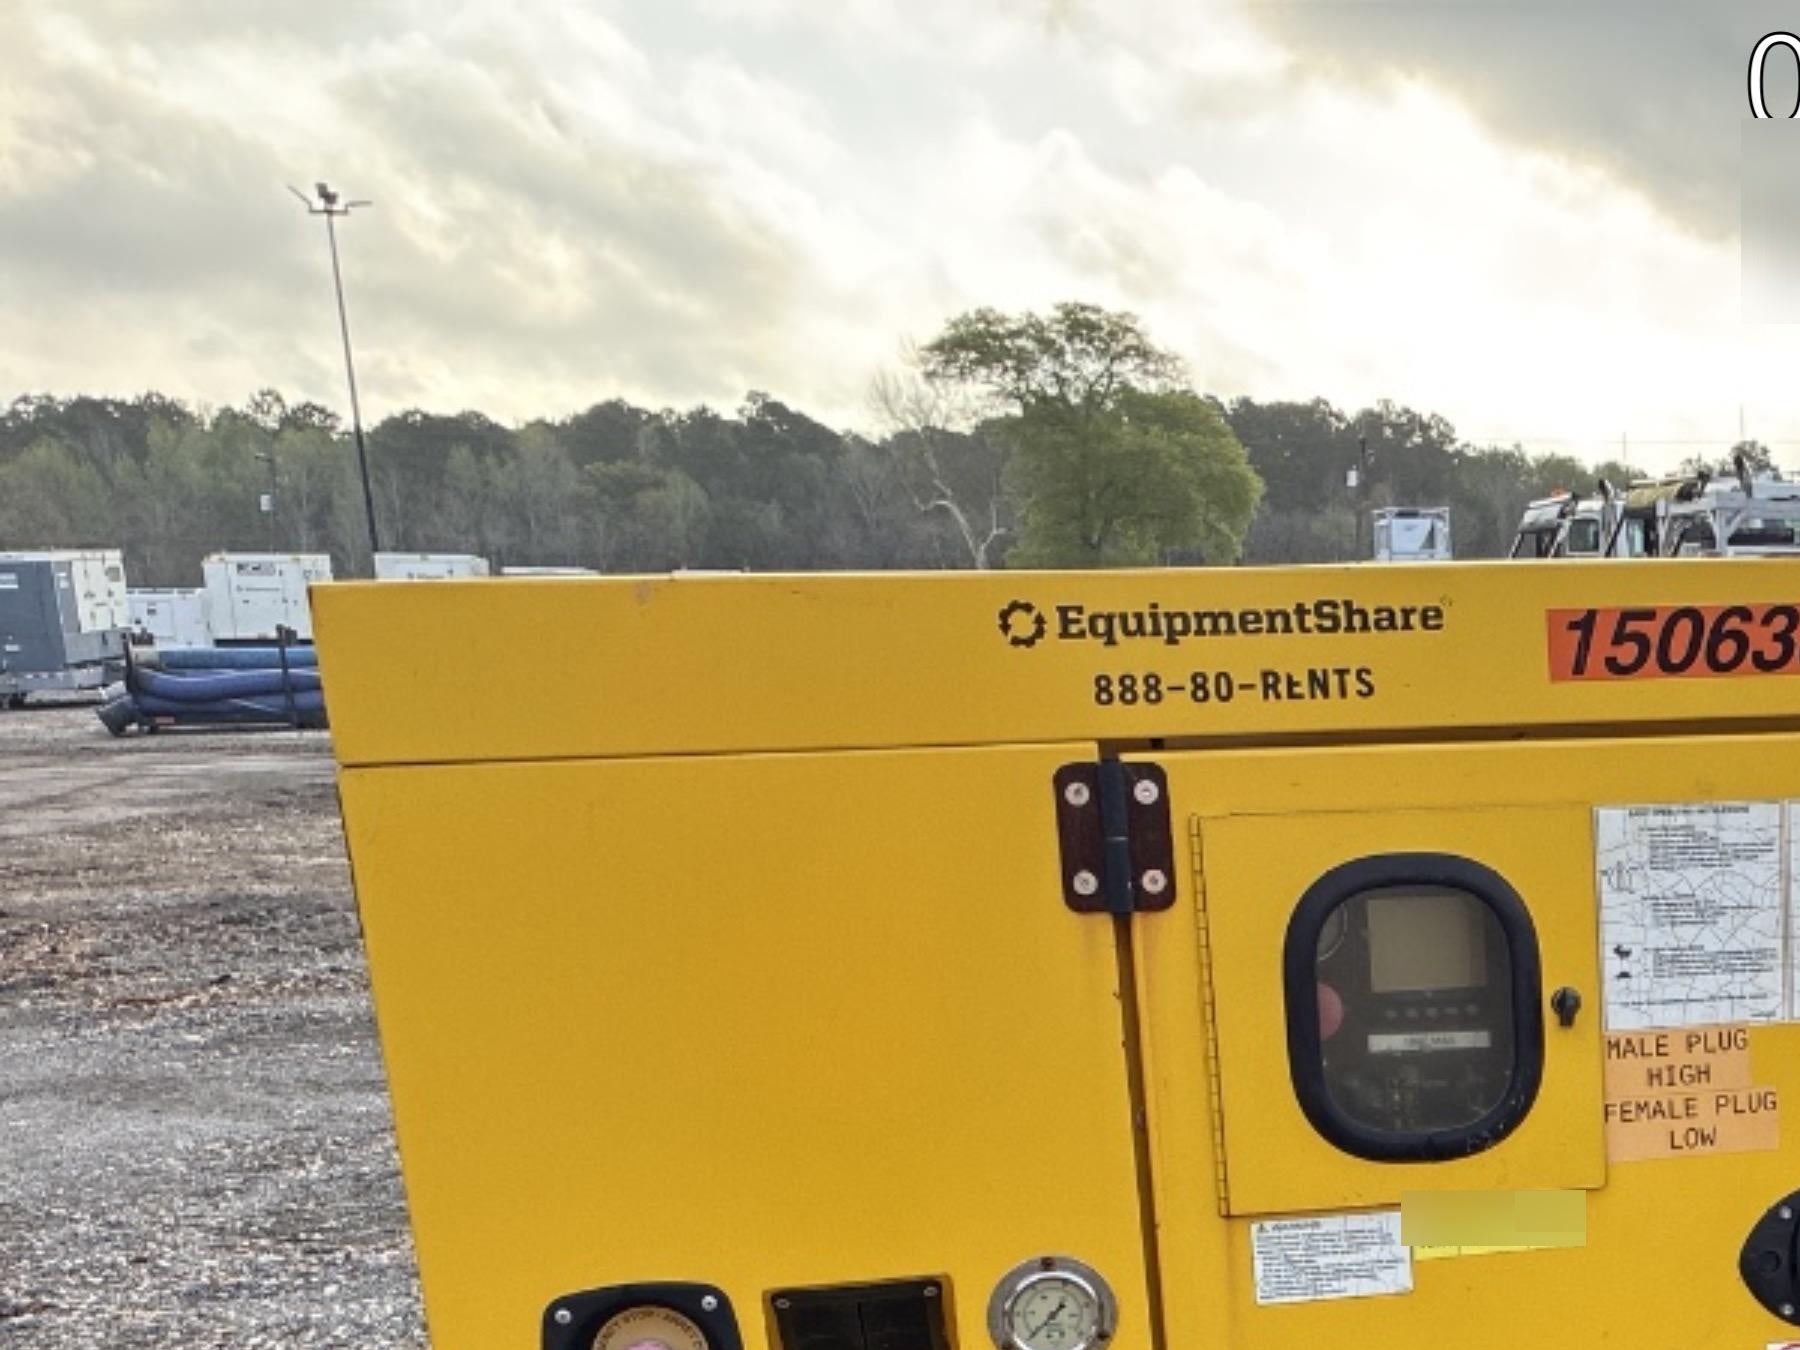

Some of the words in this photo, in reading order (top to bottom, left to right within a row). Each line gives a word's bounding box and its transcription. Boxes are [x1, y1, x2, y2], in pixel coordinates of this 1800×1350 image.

[1057, 598, 1444, 647] EquipmentShare
[1092, 667, 1376, 706] 888-80-RENTS
[1606, 1034, 1670, 1061] MALE
[1686, 1028, 1750, 1054] PLUG
[1647, 1063, 1712, 1088] HIGH
[1603, 1097, 1700, 1125] FEMALE
[1715, 1091, 1778, 1116] PLUG
[1669, 1127, 1718, 1151] LOW
